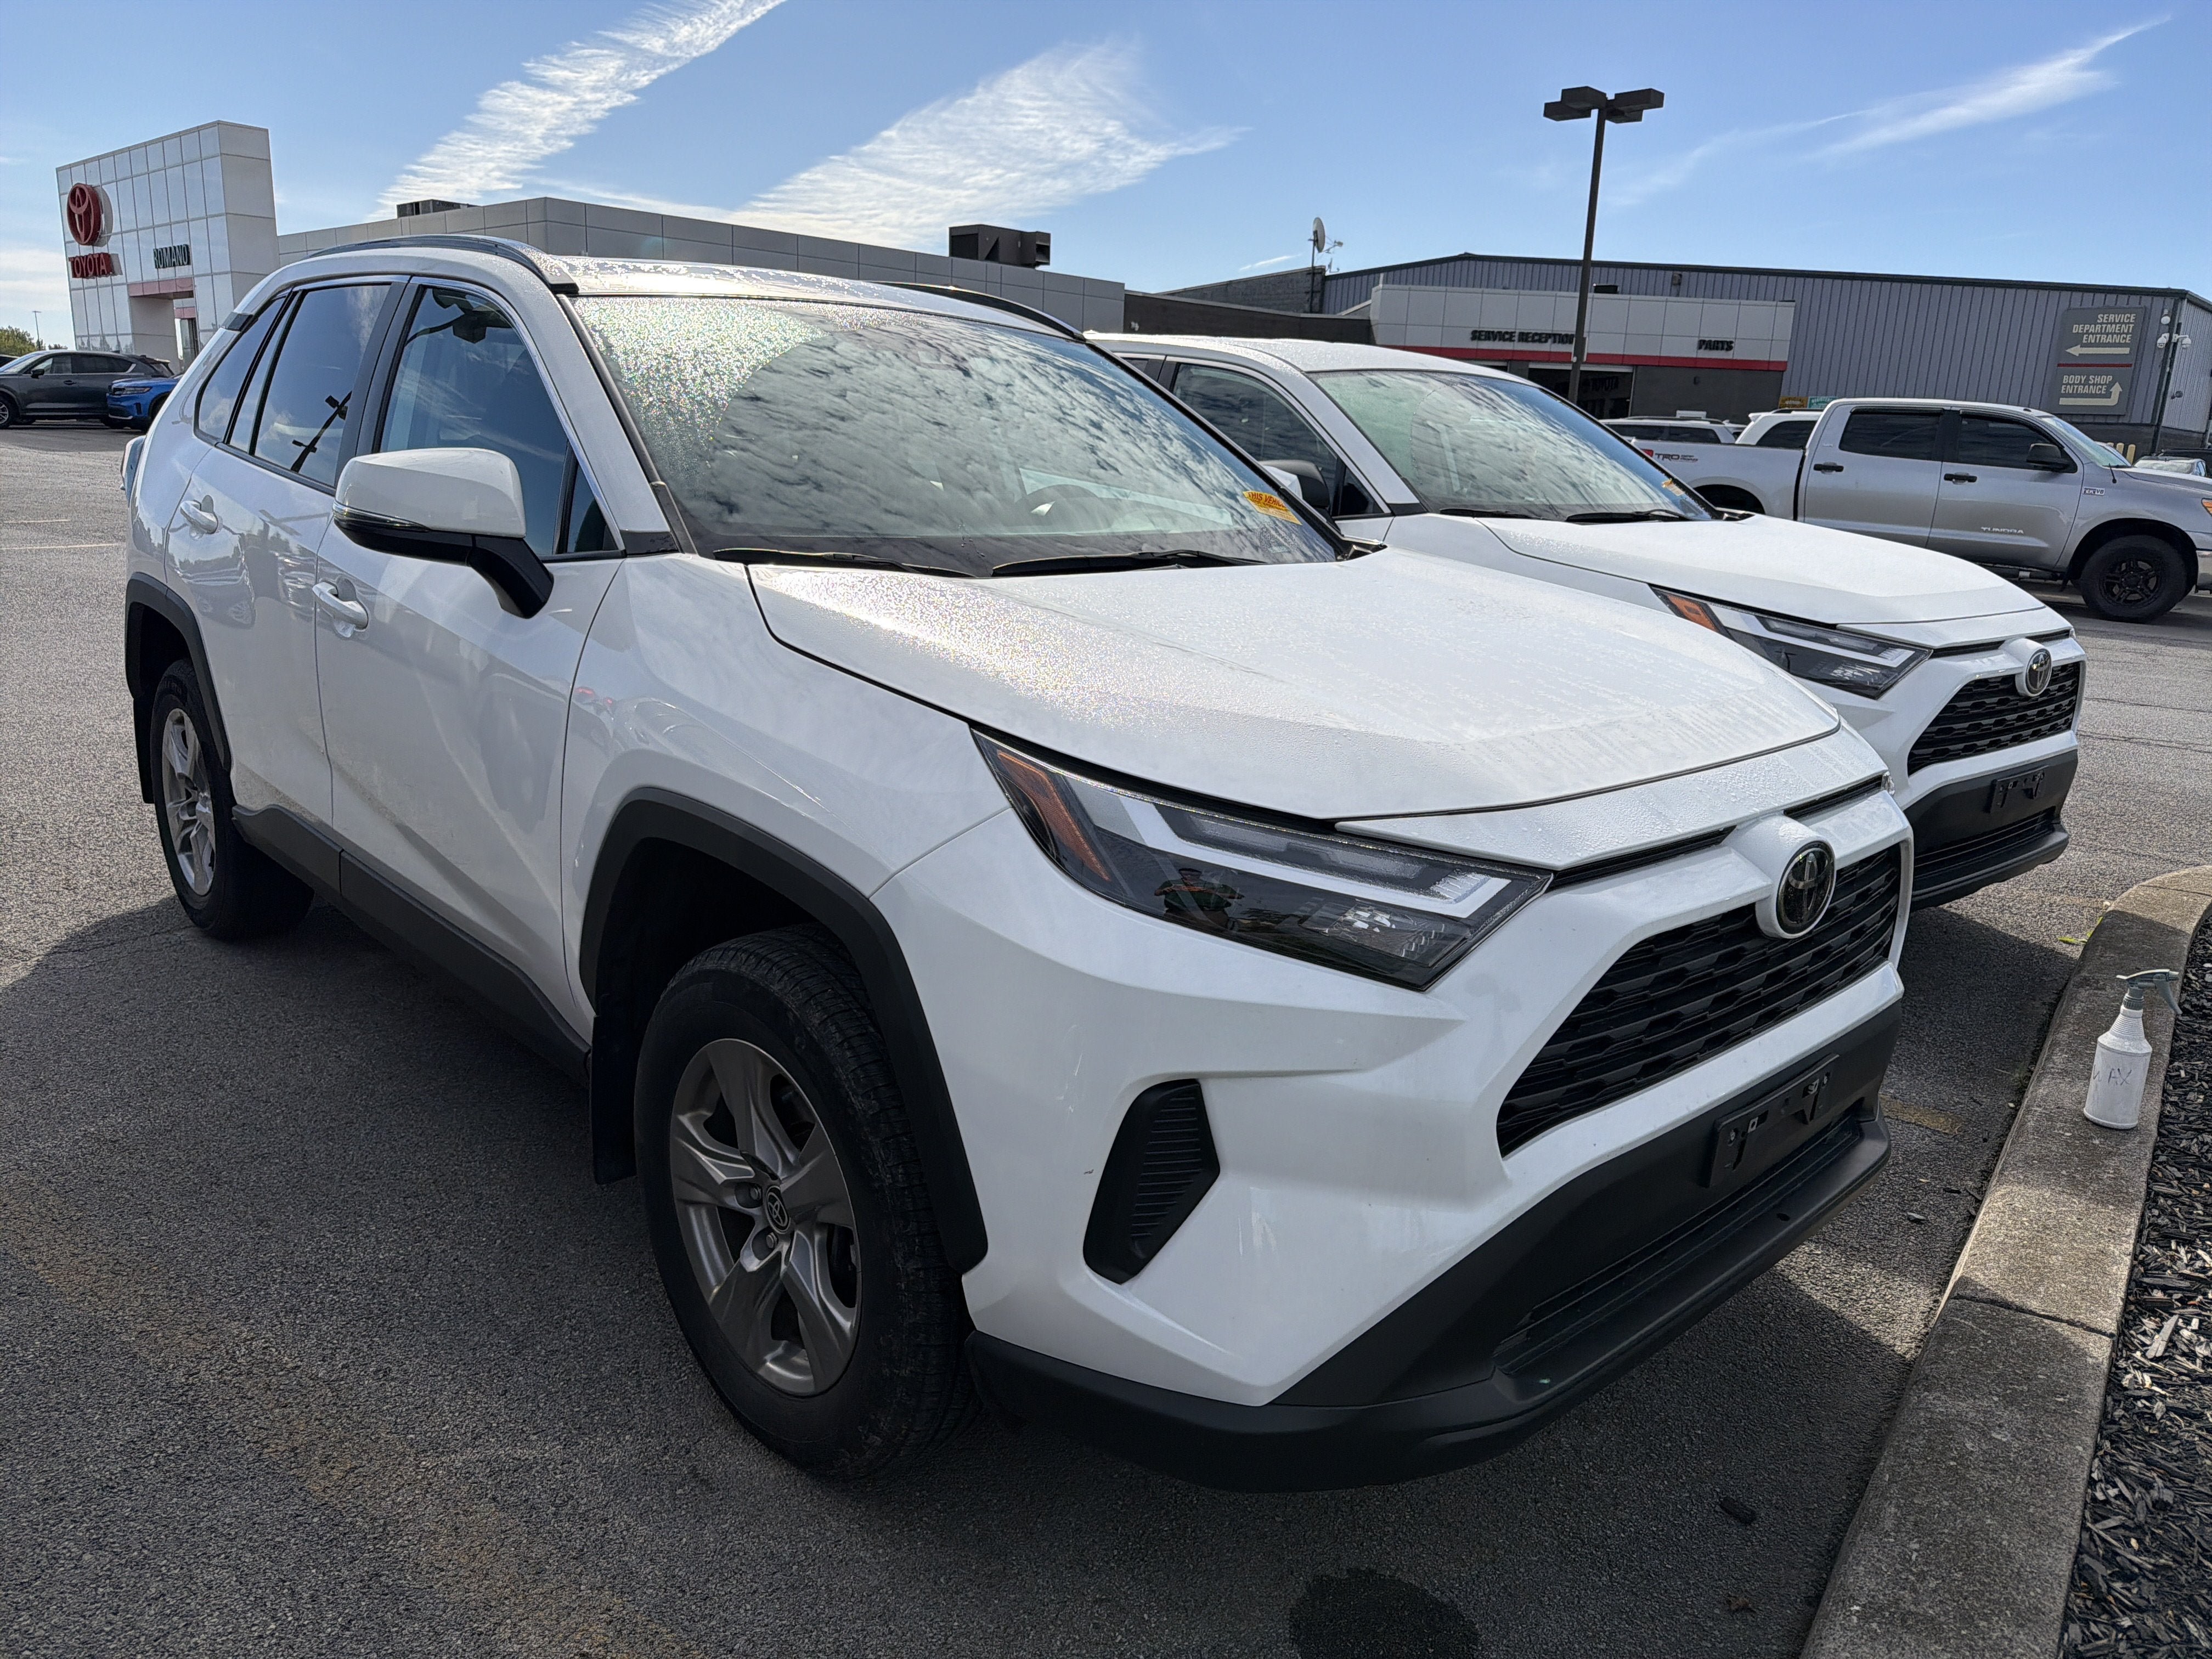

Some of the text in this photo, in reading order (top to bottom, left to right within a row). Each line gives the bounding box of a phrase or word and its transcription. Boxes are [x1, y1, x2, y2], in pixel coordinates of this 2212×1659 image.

[153, 244, 191, 269] ROMANO
[68, 252, 111, 278] TOYOTA
[2097, 314, 2136, 323] SERVICE
[2073, 324, 2134, 333] DEPARTMENT
[1471, 330, 1575, 345] SERVICE RECEPTION
[2082, 334, 2132, 343] ENTRANCE
[1698, 339, 1734, 351] PARTS
[2063, 375, 2113, 384] BODY SHOP
[2061, 385, 2107, 394] ENTRANCE
[1248, 492, 1263, 500] THIS
[1981, 526, 2024, 534] TUNDRA
